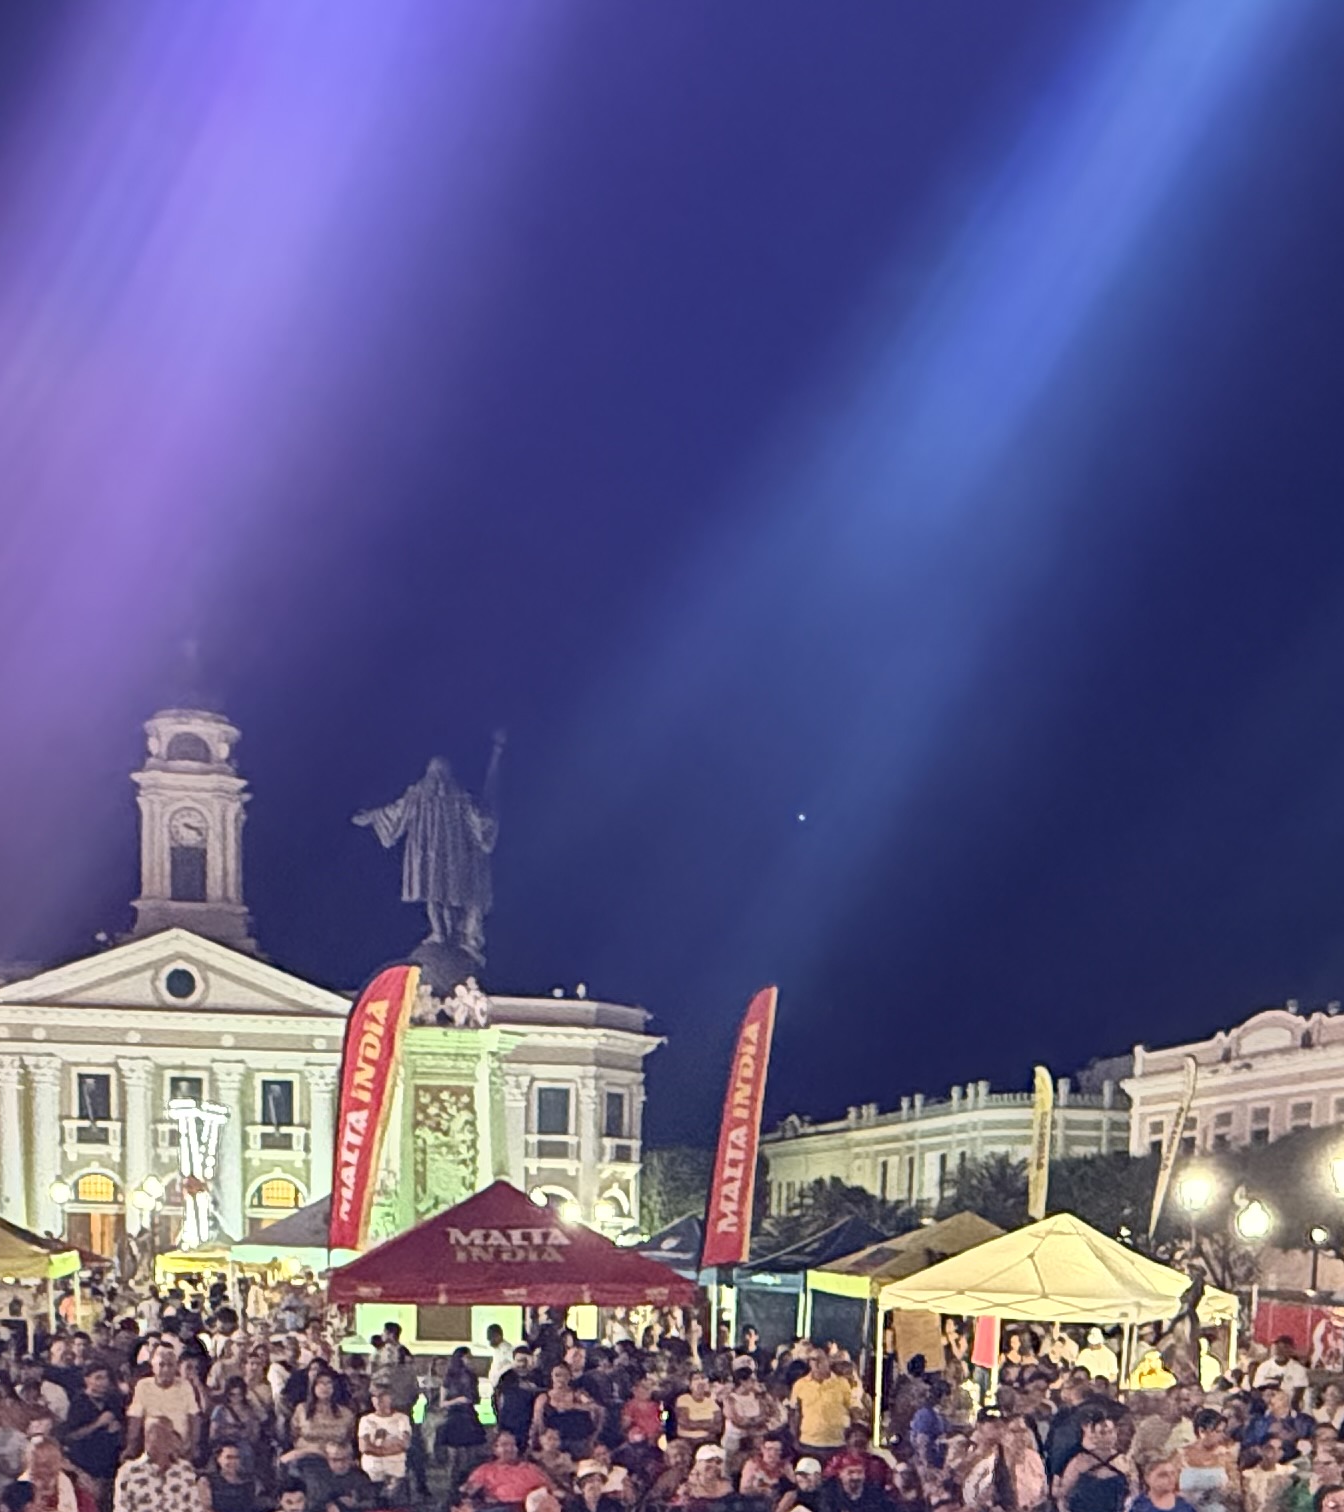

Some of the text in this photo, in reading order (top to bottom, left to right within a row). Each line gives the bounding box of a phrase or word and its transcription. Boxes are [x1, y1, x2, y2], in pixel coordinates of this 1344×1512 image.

[350, 998, 391, 1104] INDIA
[717, 1021, 762, 1235] MALTA INDIA
[445, 1228, 572, 1246] MALTA
[455, 1246, 566, 1263] INDIA
